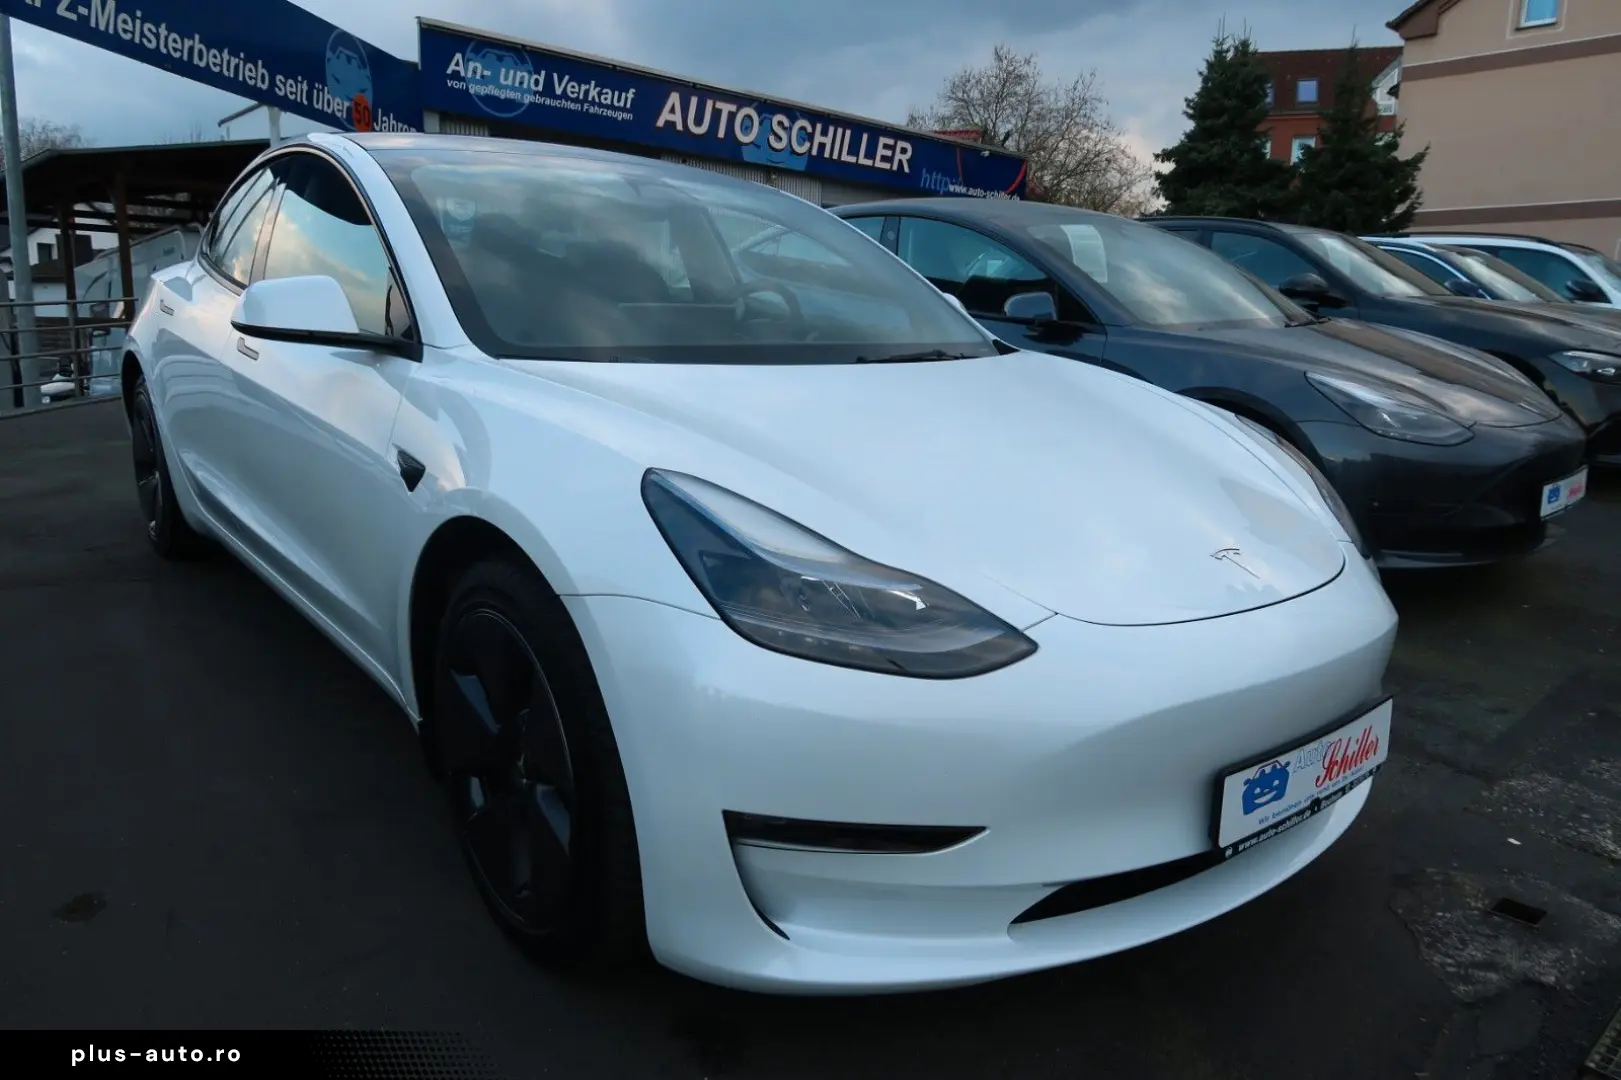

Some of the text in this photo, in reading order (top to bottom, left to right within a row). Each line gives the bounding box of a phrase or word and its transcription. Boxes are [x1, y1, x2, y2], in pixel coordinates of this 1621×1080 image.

[275, 74, 308, 105] seit
[313, 82, 349, 119] über
[446, 52, 636, 109] An- und Verkauf
[447, 79, 633, 121] von gepflegten gebrauchten Fahrzeugen
[655, 91, 913, 173] AUTO SCHILLER
[1315, 724, 1379, 788] Schiller
